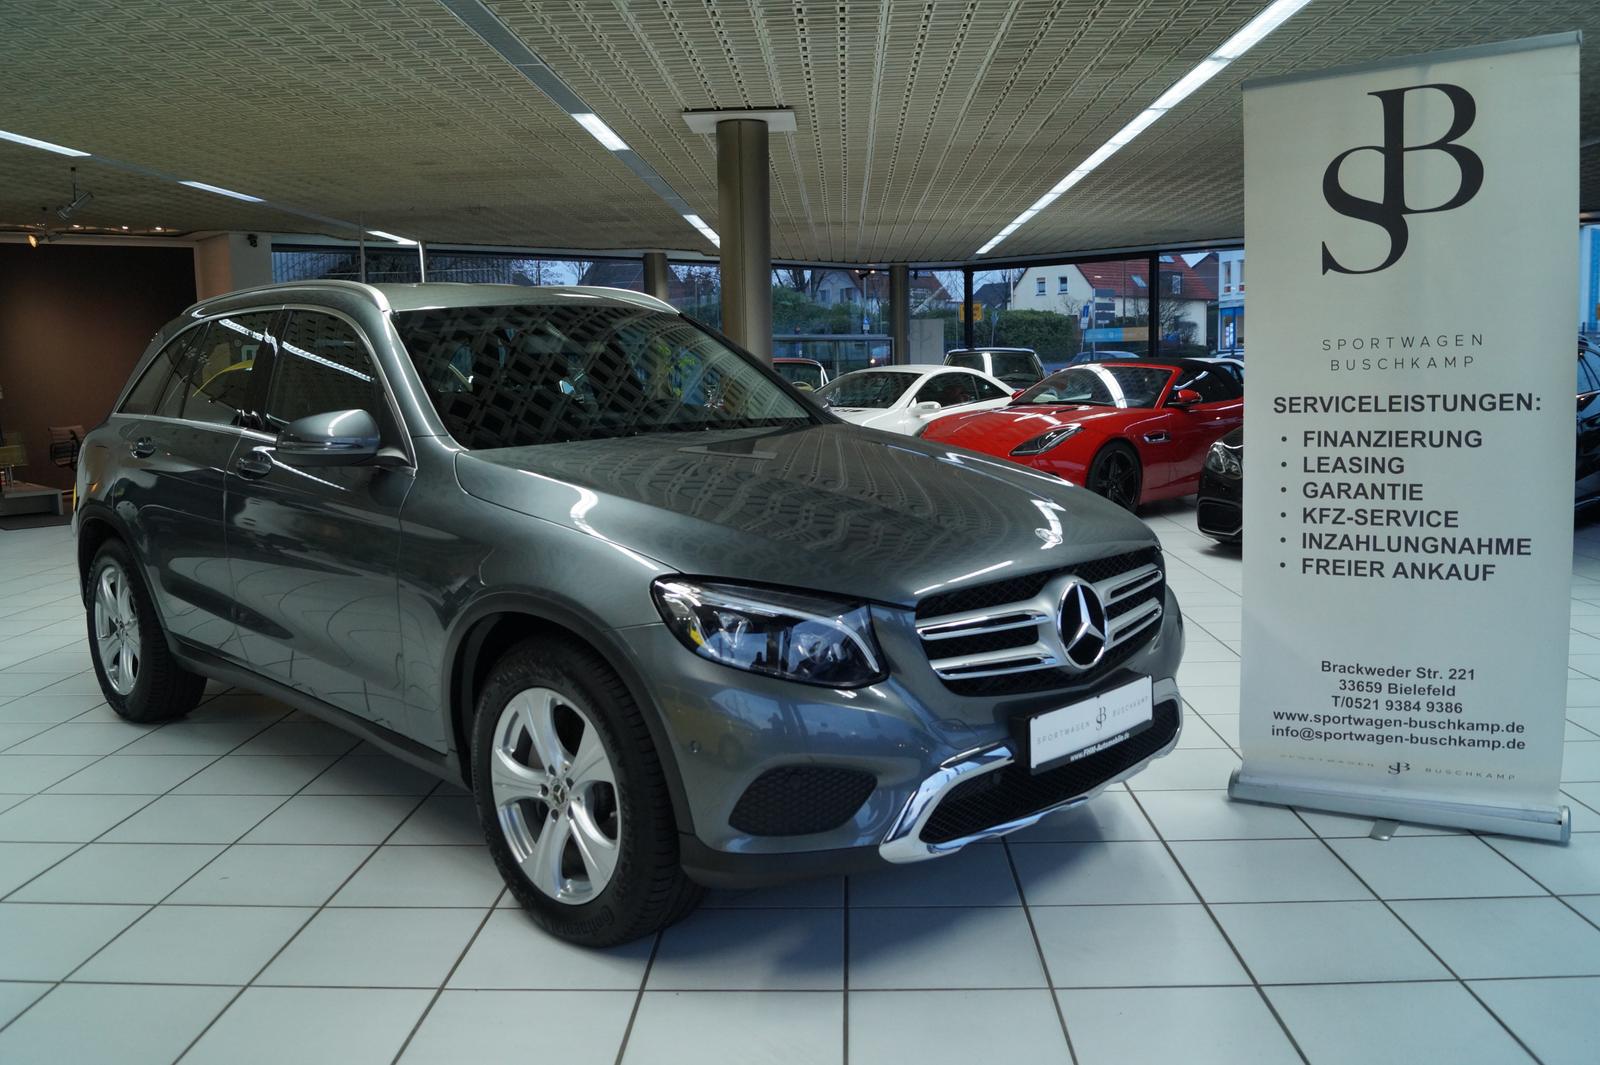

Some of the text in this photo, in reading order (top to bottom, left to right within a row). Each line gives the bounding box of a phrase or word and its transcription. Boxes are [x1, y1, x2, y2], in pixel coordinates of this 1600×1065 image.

[1321, 333, 1484, 352] SPORTWAGEN
[1330, 354, 1474, 372] BUSCHKAMP
[1273, 392, 1541, 414] SERVICELEISTUNGEN:
[1303, 430, 1483, 449] FINANZIERUNG
[1303, 456, 1405, 475] LEASING
[1302, 481, 1424, 502] GARANTIE
[1302, 507, 1459, 529] KFZ-SERVICE
[1302, 532, 1532, 556] INZAHLUNGNAHME
[1301, 557, 1496, 582] FREIER ANKAUF
[1321, 660, 1475, 681] Brackweder Str. 221
[1339, 678, 1456, 697] 33659 Bielefeld
[1331, 695, 1463, 714] T/0521 9384 9386
[1273, 710, 1525, 735] www.sportwagen-buschkamp.de
[1271, 725, 1526, 751] info@sportwagen-buschkamp.de
[1425, 767, 1516, 781] BUSCHKAMP
